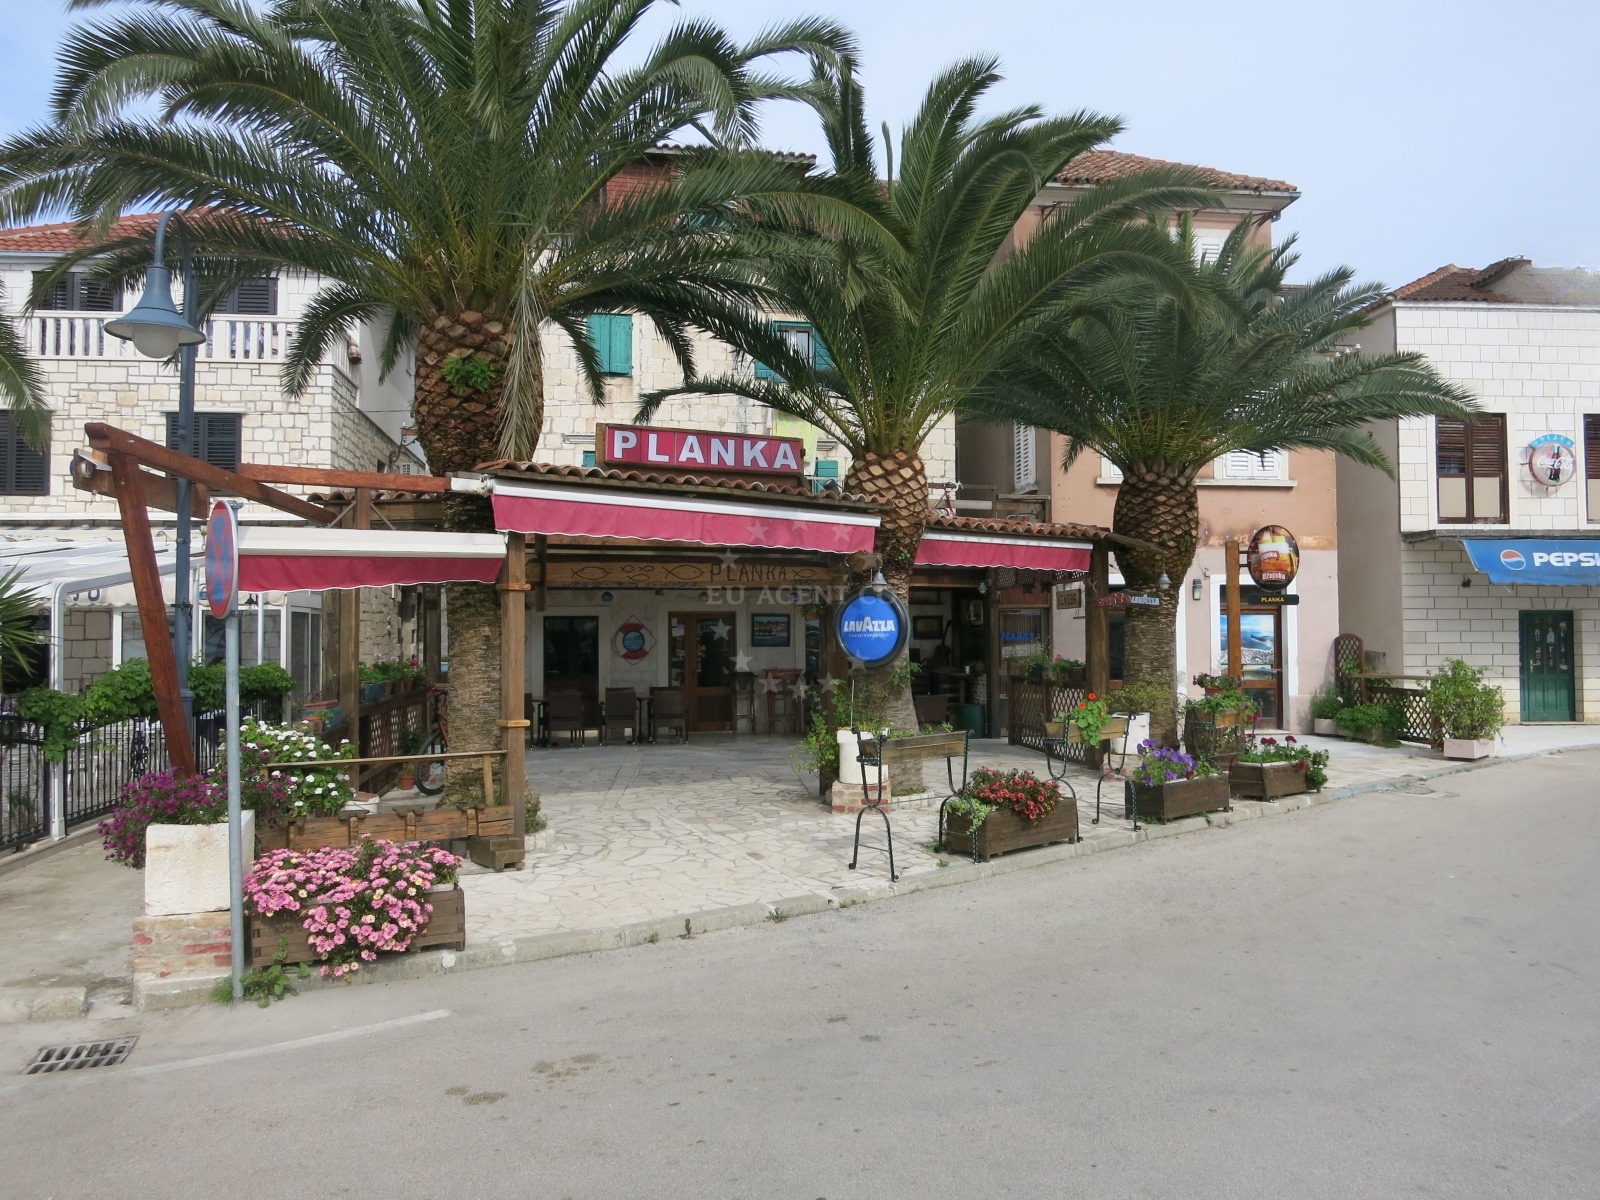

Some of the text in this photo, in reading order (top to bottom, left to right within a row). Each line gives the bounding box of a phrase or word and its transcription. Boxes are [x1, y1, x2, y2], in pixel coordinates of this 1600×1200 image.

[613, 430, 799, 470] PLANKA
[1532, 552, 1600, 567] PEPSI
[710, 563, 787, 583] PLANKA
[843, 616, 896, 632] LAVAZZA
